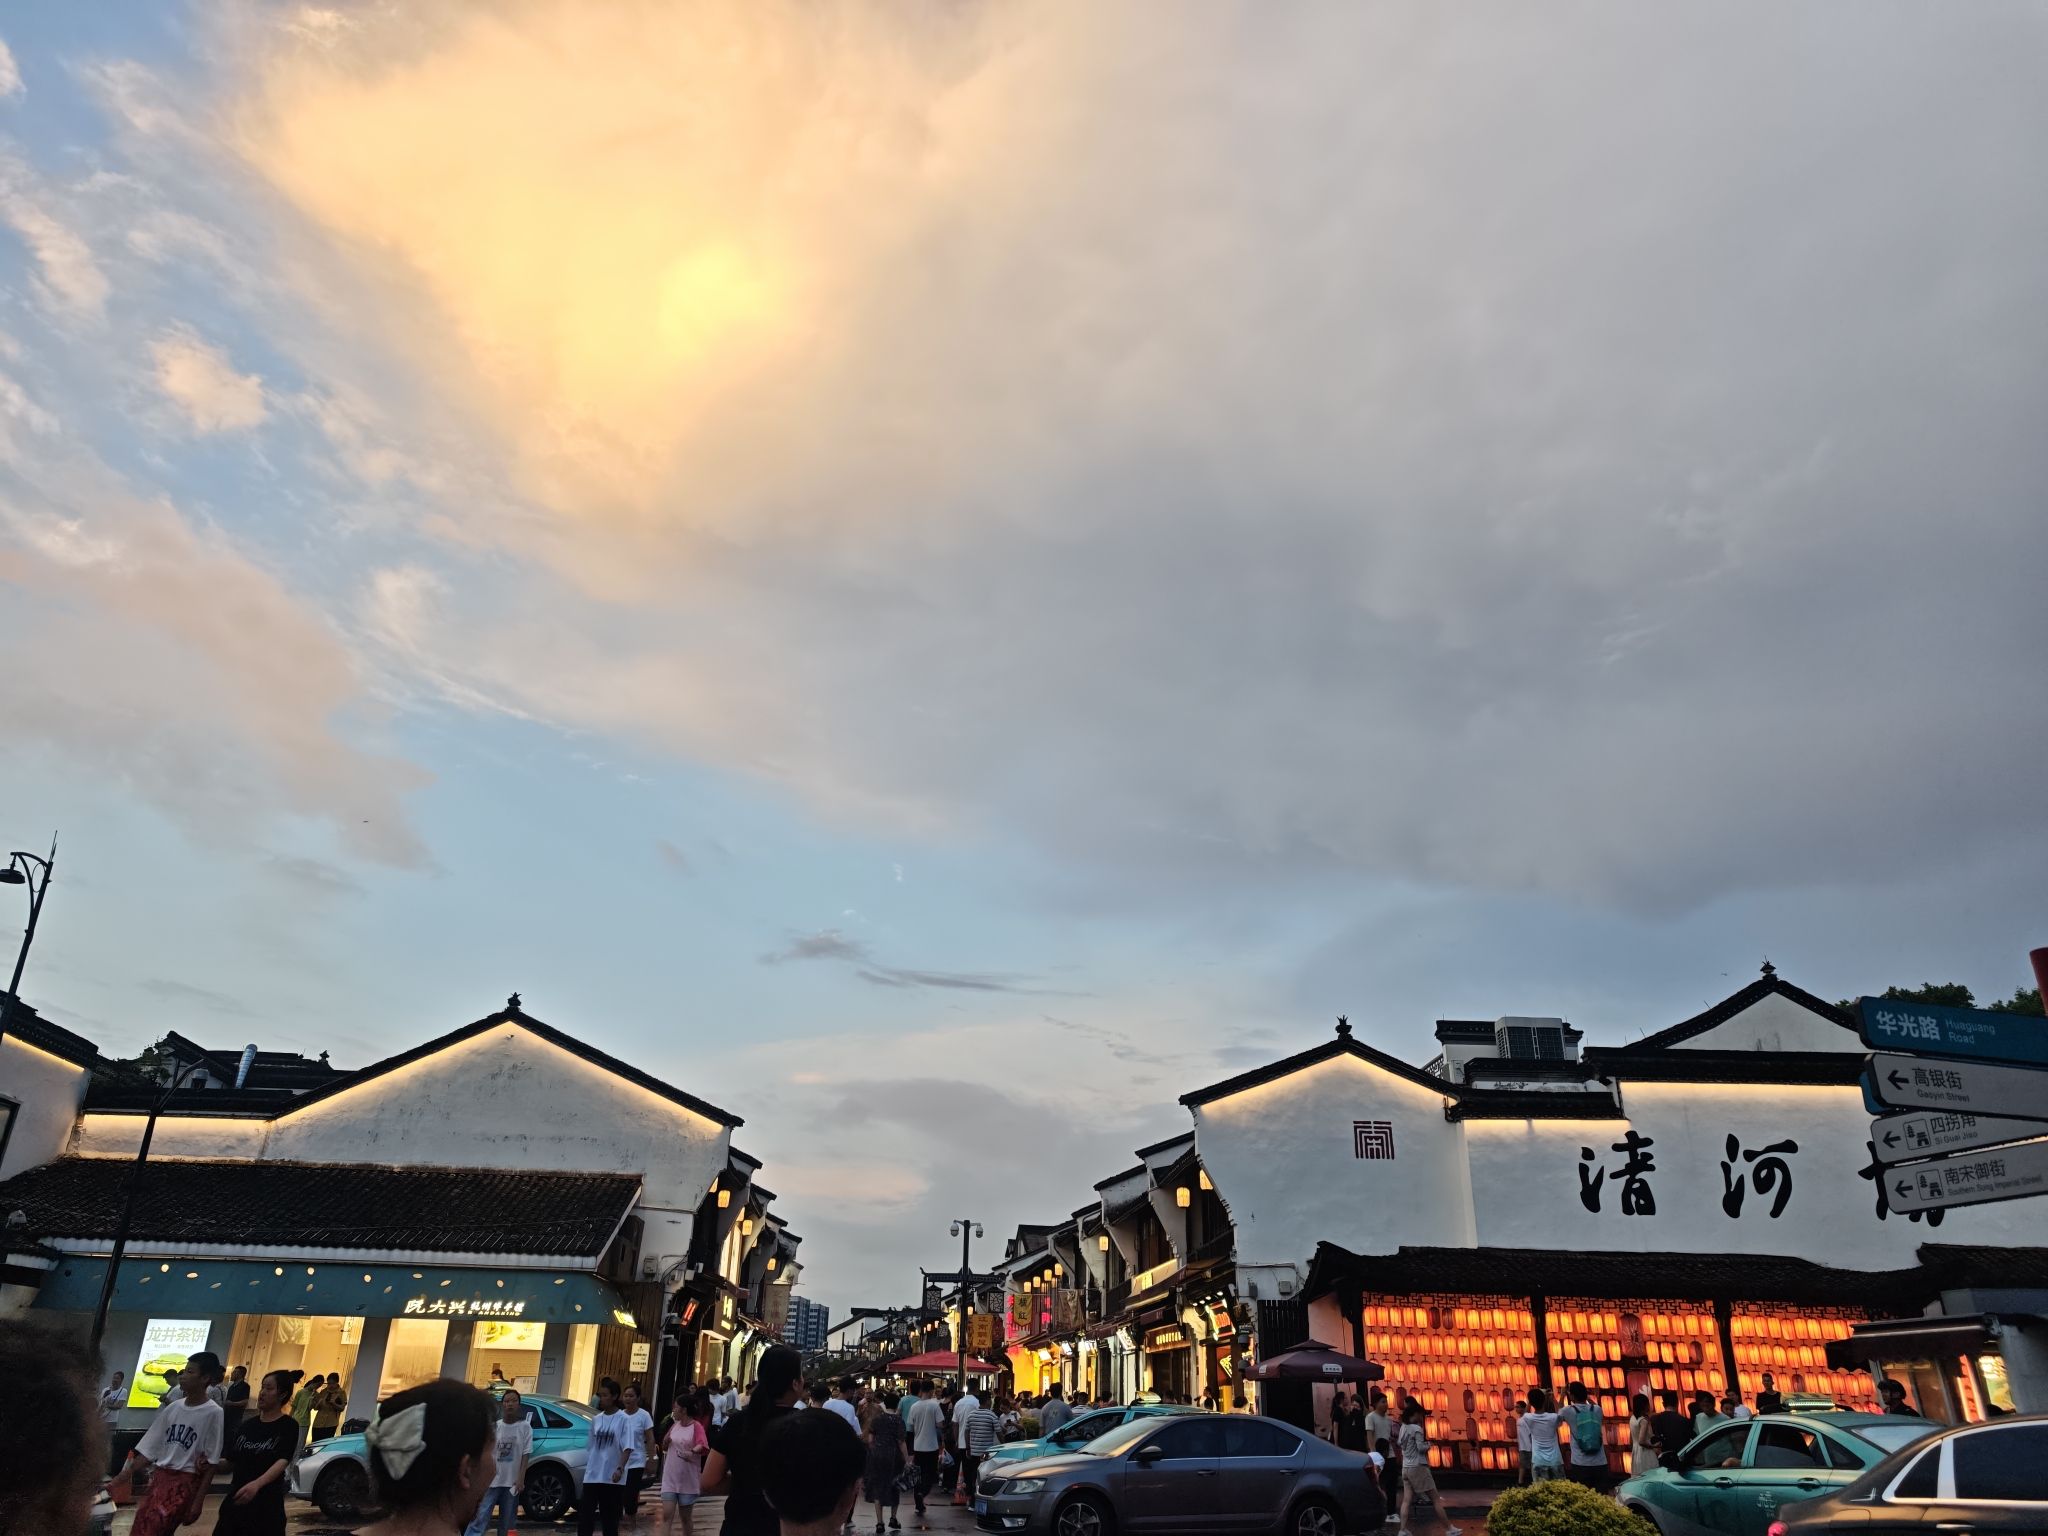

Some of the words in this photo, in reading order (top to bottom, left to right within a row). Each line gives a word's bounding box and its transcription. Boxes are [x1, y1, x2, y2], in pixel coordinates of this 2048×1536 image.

[1876, 1010, 1941, 1041] 华光路
[1945, 1019, 1996, 1035] Huaguang
[1948, 1031, 1975, 1044] Road
[1912, 1066, 1963, 1090] 高银街
[1916, 1089, 1945, 1101] Gaoyin
[1946, 1092, 1970, 1103] Street
[1930, 1114, 1977, 1135] 四拐角
[1935, 1137, 1943, 1145] Si
[1944, 1135, 1961, 1144] Guai
[1962, 1131, 1978, 1140] Jiao
[1943, 1159, 2006, 1185] 南宋御街
[146, 1326, 207, 1343] 龙井茶饼
[166, 1424, 198, 1450] ARIS
